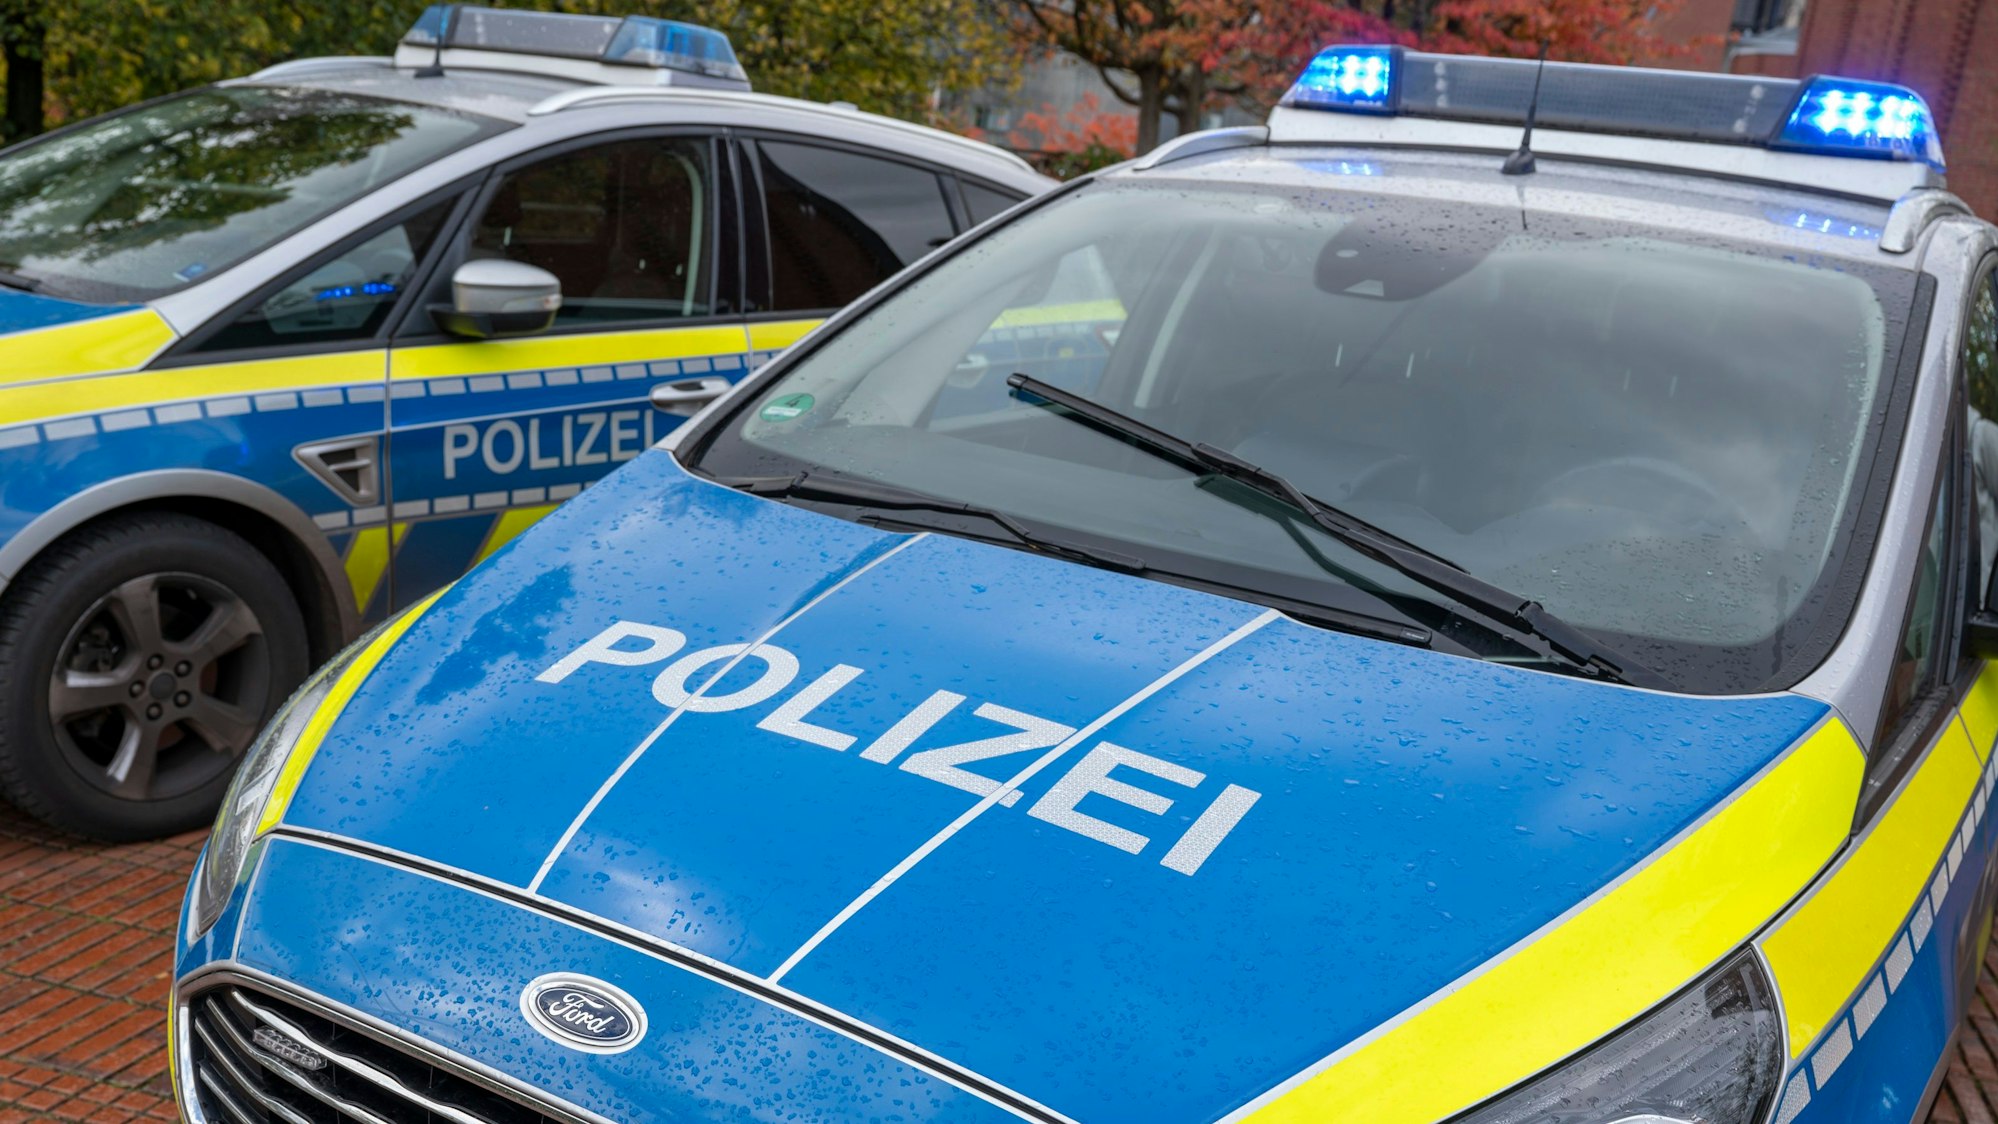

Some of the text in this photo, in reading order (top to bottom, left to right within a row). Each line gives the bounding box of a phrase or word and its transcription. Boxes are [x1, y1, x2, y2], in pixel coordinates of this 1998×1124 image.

[443, 409, 654, 480] POLIZEI
[534, 620, 1262, 876] POLIZEI
[549, 992, 615, 1034] Ford
